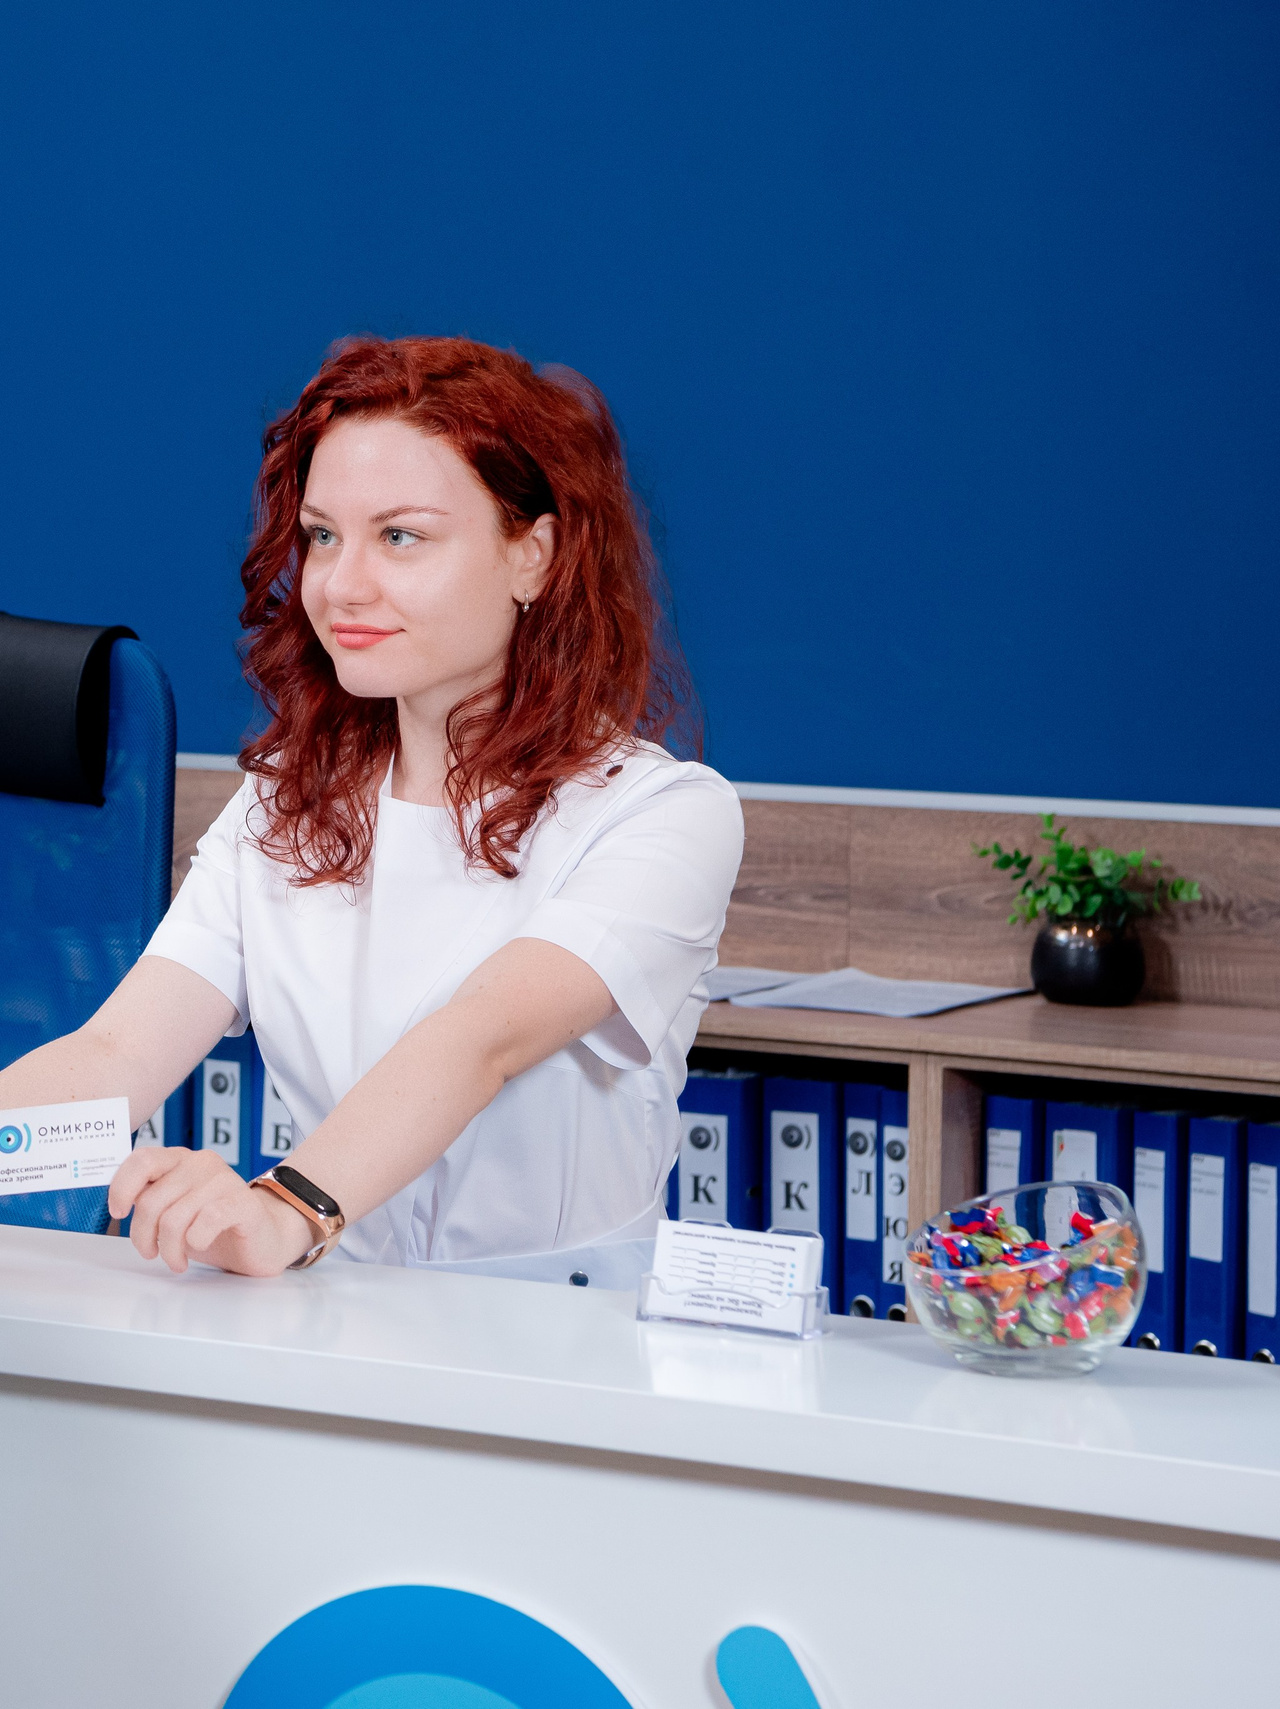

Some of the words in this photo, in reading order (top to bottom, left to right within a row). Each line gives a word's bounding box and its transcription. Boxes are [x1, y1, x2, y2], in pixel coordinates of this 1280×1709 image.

[38, 1120, 115, 1137] ОМИКРОН
[212, 1117, 231, 1145] Б
[273, 1123, 291, 1151] Б
[16, 1173, 44, 1183] зрения
[690, 1174, 718, 1204] К
[851, 1170, 873, 1196] Л
[888, 1173, 906, 1196] Э
[783, 1180, 809, 1211] К
[884, 1215, 908, 1240] Ю
[888, 1261, 904, 1284] Я
